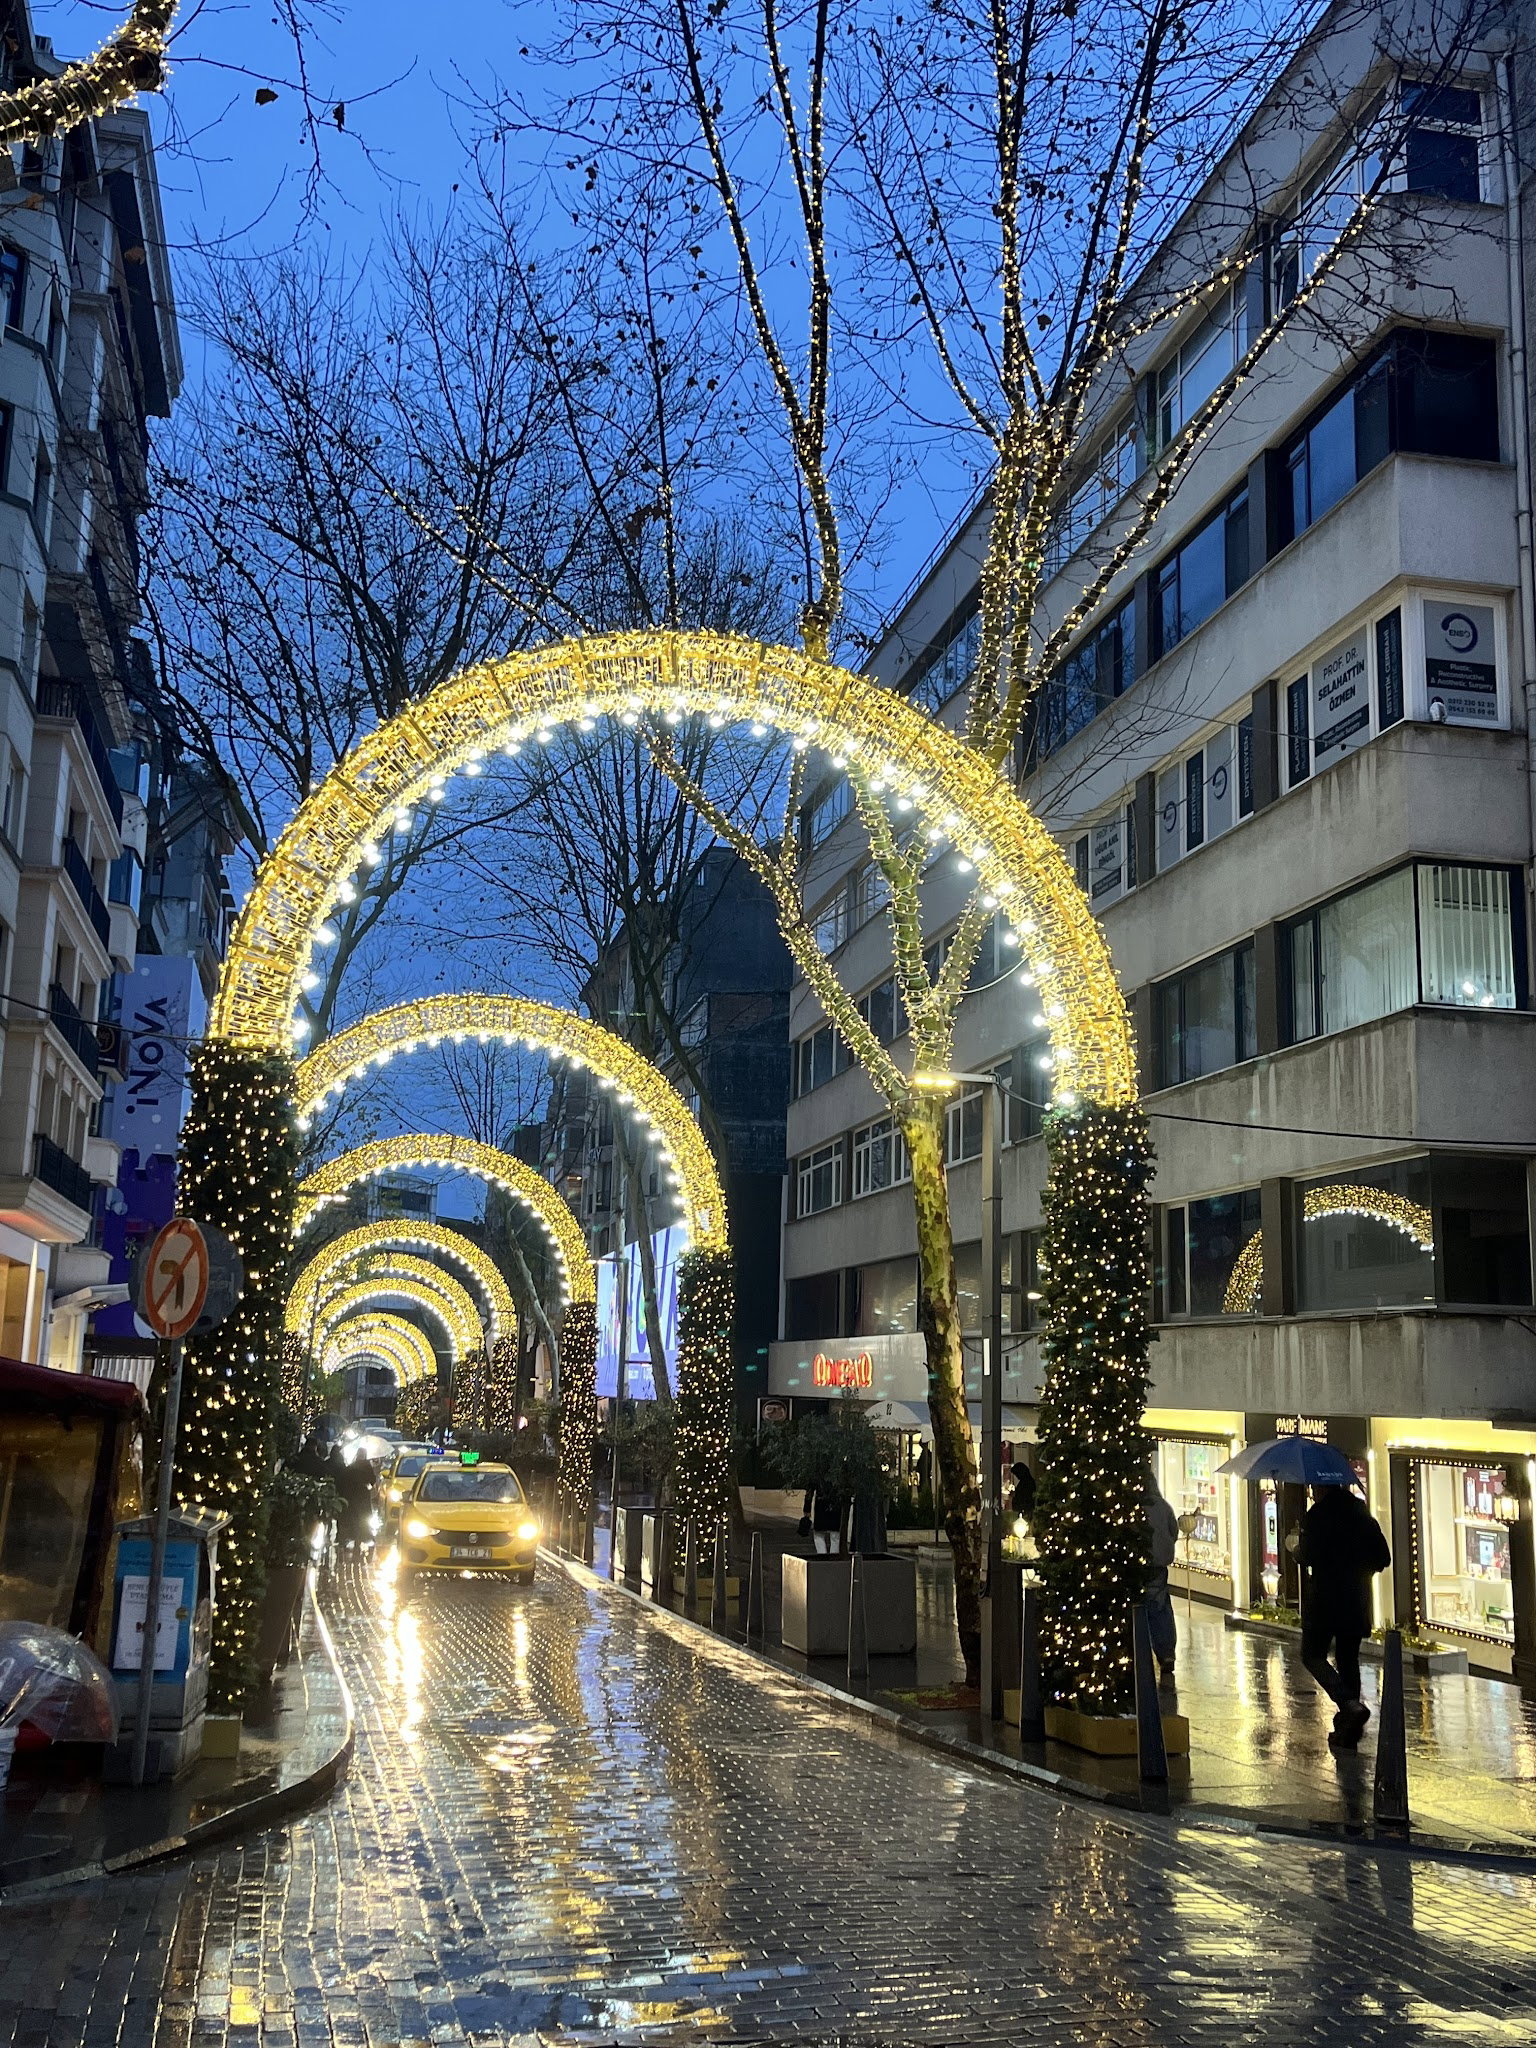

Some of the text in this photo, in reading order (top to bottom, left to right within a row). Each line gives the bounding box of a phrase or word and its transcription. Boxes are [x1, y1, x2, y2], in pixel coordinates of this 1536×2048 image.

[1318, 659, 1365, 701] SELAHATTİN
[1323, 648, 1358, 680] PROF. DR.
[1329, 685, 1356, 712] ÖZMEN
